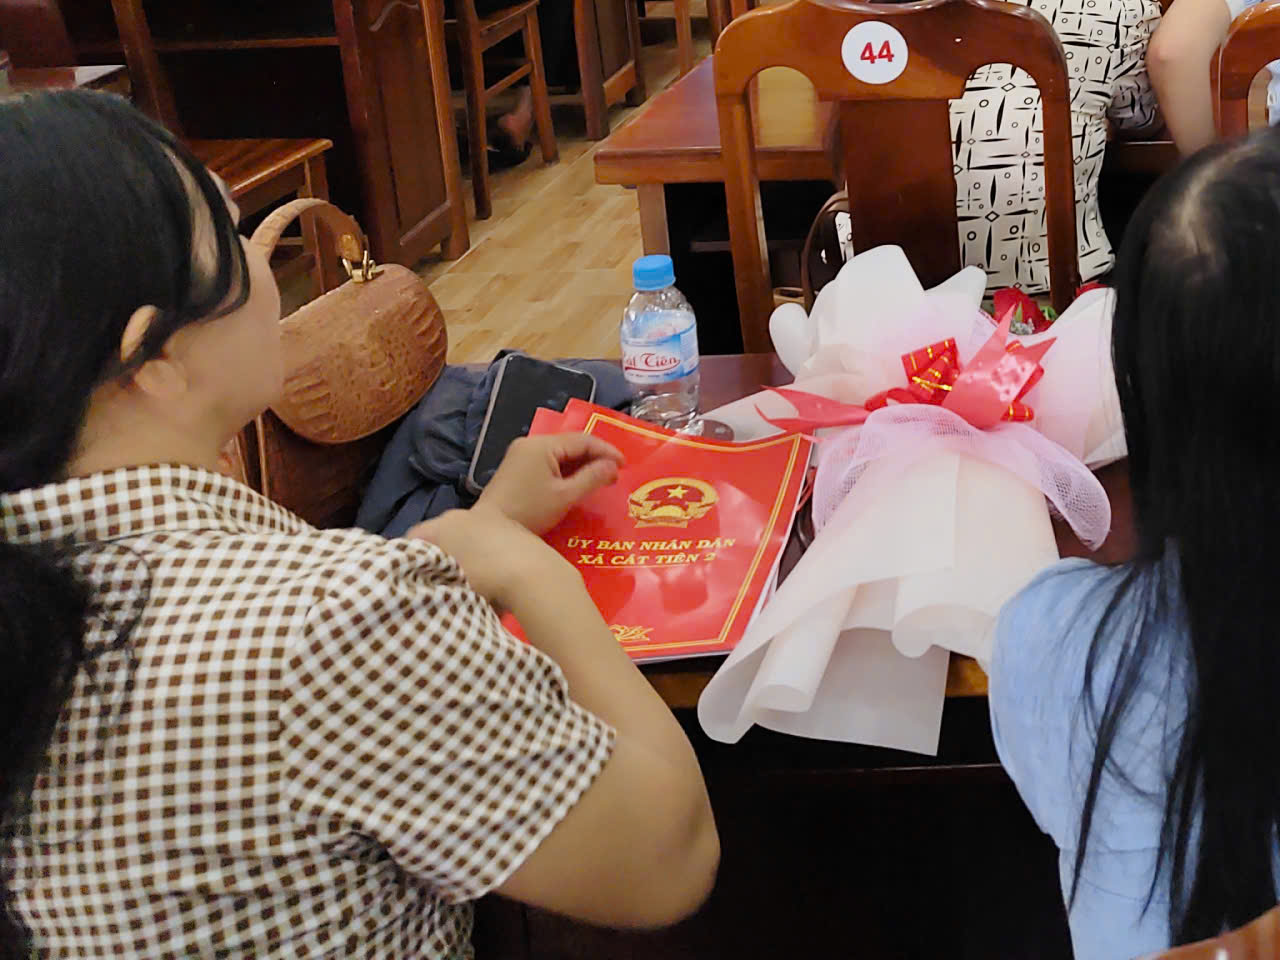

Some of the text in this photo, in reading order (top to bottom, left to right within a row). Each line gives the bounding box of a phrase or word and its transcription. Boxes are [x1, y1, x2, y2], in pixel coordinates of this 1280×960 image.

[860, 40, 895, 64] 44
[596, 539, 635, 551] BAN
[639, 538, 692, 551] NHÂN
[696, 537, 737, 550] DÂN
[610, 553, 650, 566] CÁT
[655, 552, 700, 565] TIÊN
[703, 551, 718, 562] 2
